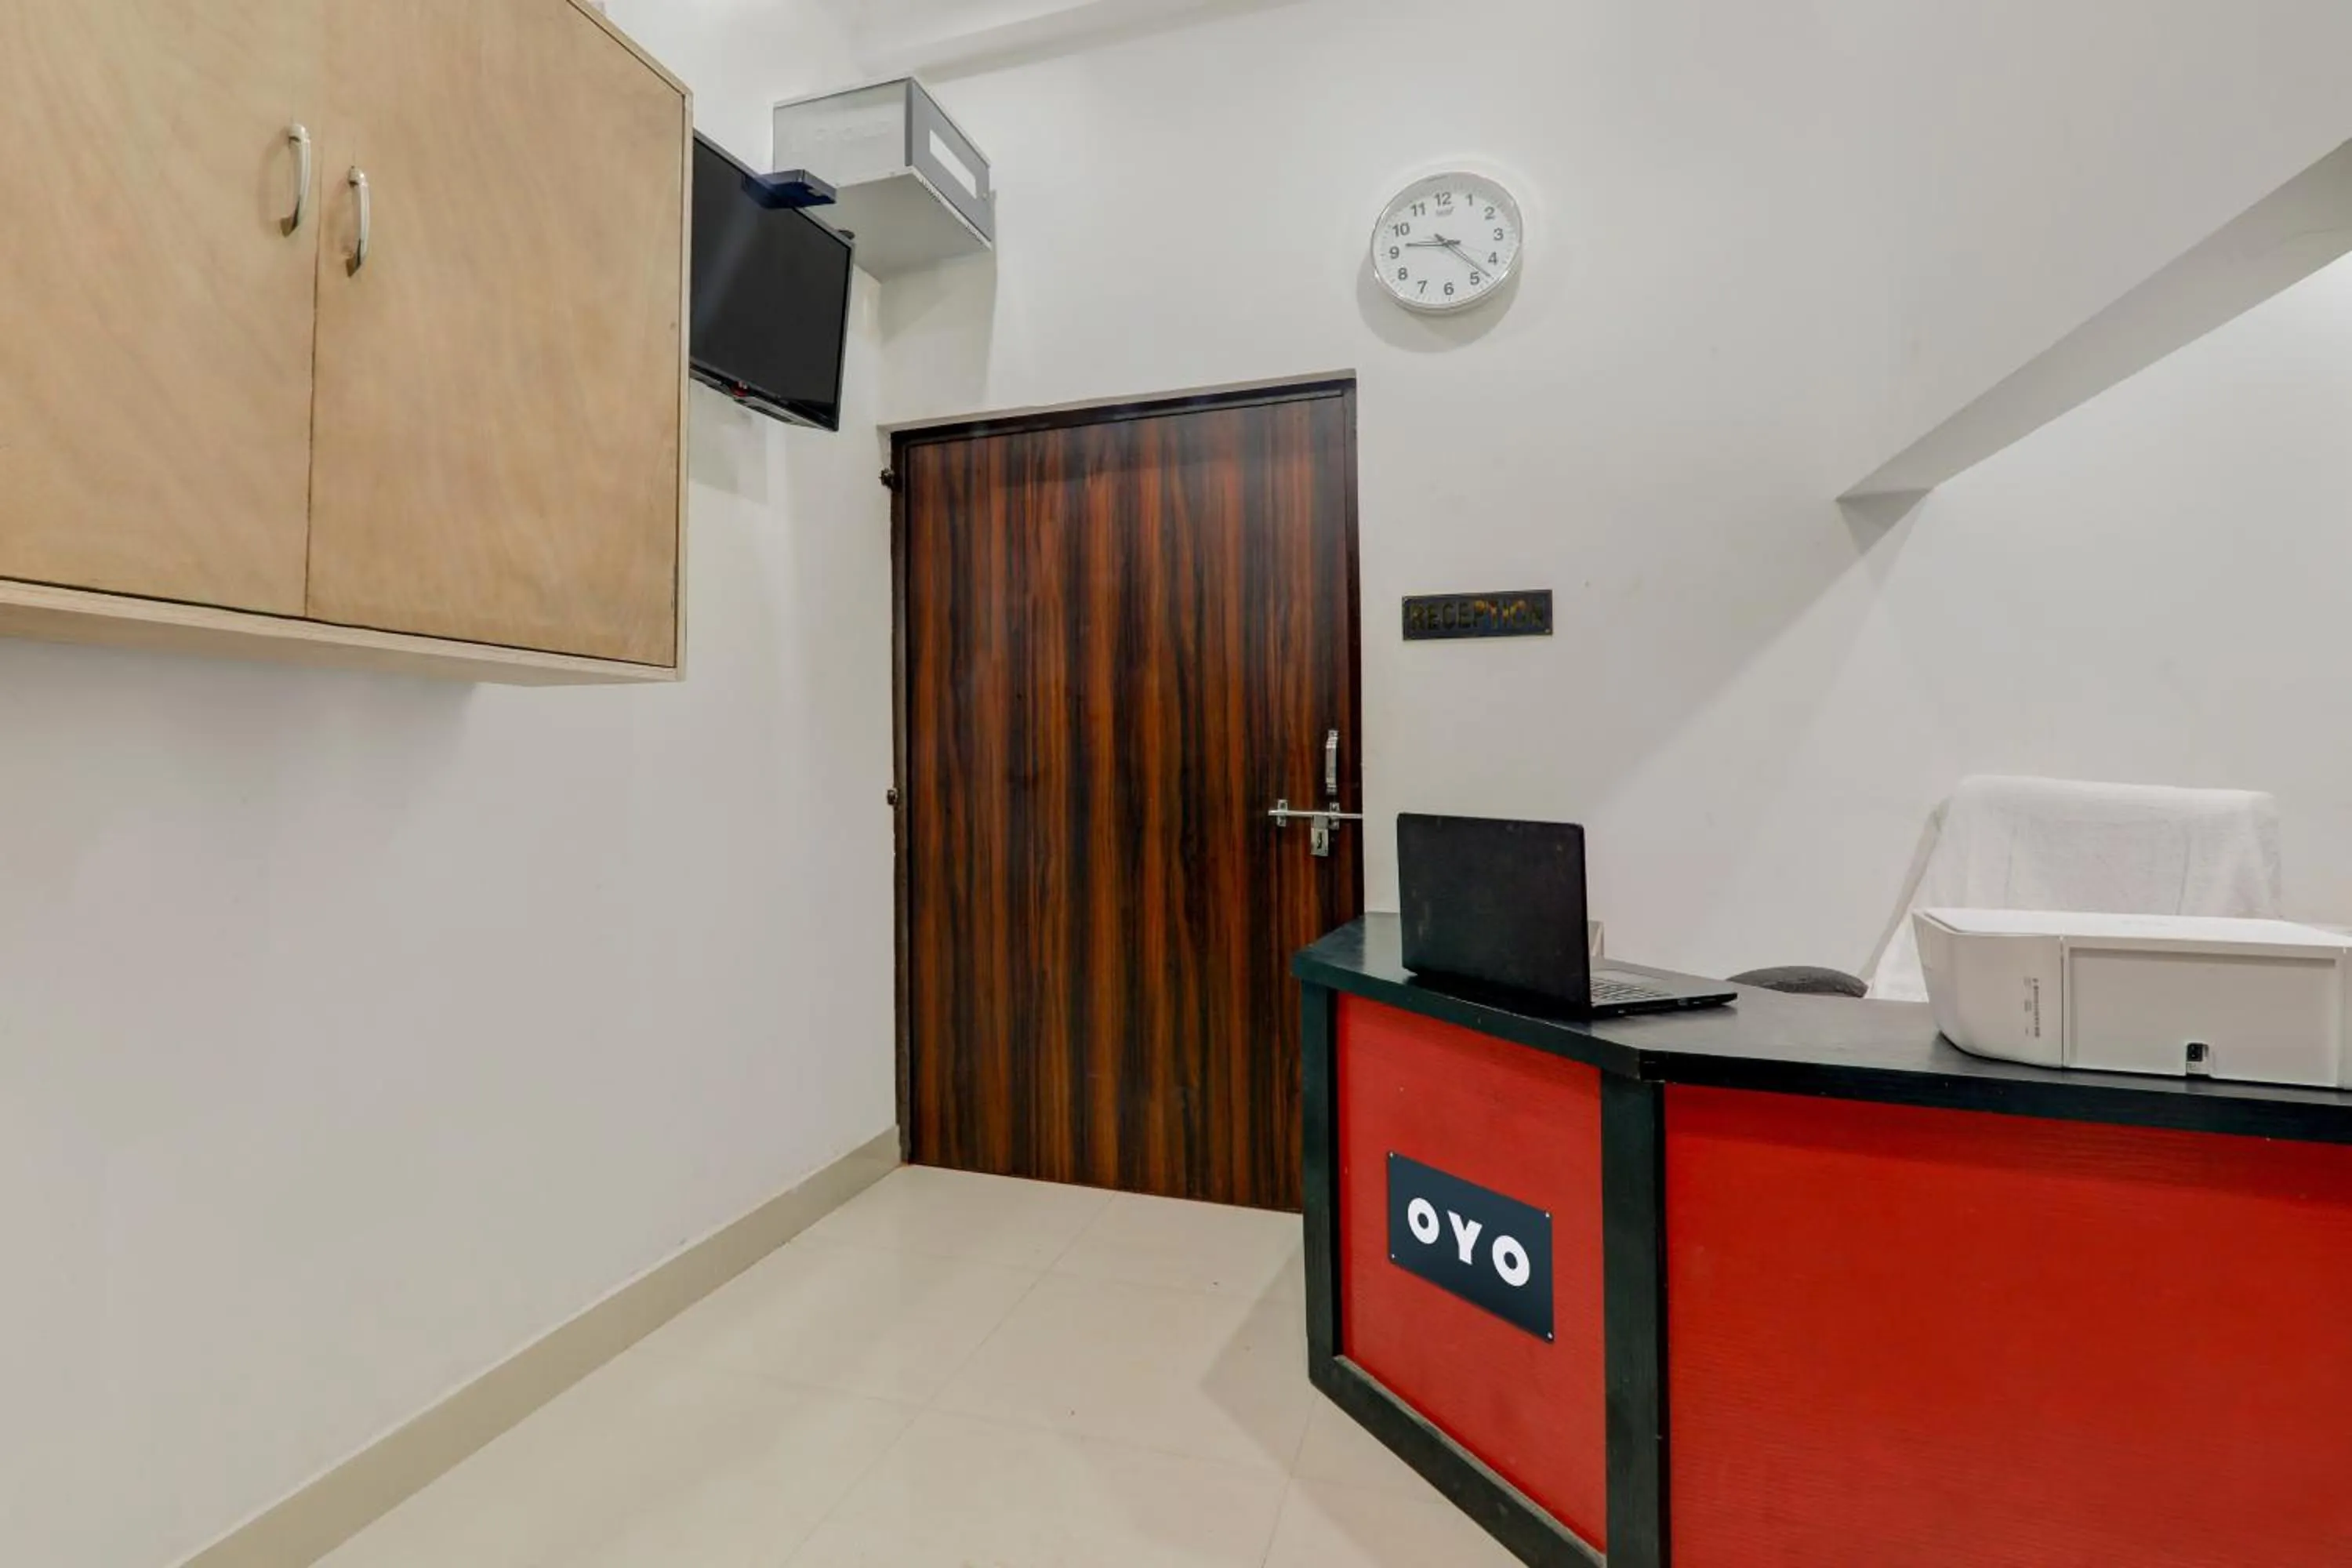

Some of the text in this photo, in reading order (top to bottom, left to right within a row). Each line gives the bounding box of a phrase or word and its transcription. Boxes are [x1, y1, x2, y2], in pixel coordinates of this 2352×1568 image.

[1435, 192, 1452, 206] 12
[1465, 194, 1474, 206] 1
[1411, 202, 1426, 216] 11
[1484, 207, 1495, 220] 2
[1392, 223, 1410, 237] 10
[1493, 228, 1504, 241] 3
[1389, 246, 1399, 259] 9
[1487, 252, 1498, 265] 4
[1398, 267, 1408, 280] 8
[1469, 272, 1480, 285] 5
[1417, 280, 1427, 294] 7
[1443, 282, 1454, 296] 6
[1407, 1197, 1530, 1287] OYO
